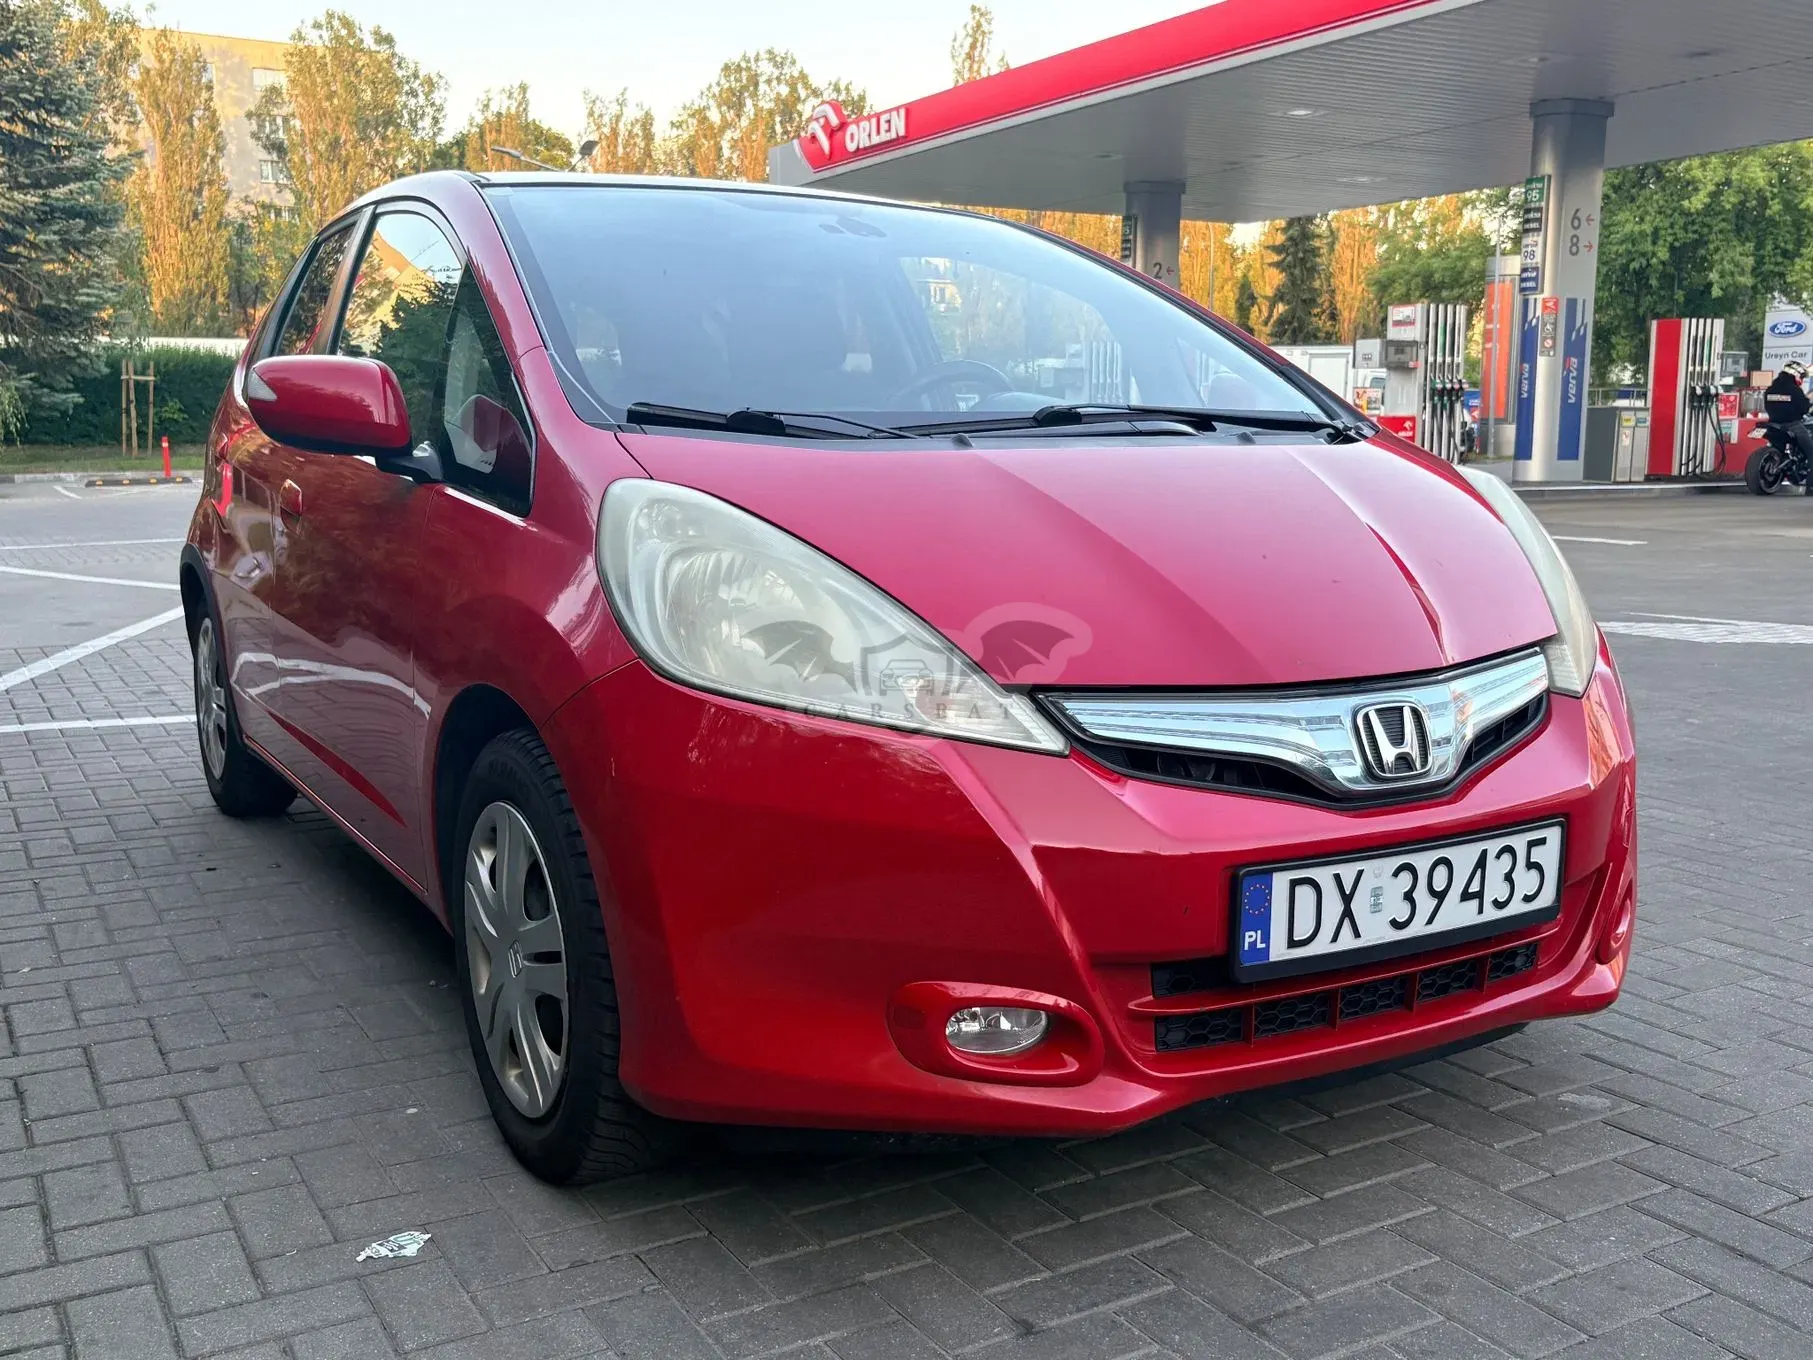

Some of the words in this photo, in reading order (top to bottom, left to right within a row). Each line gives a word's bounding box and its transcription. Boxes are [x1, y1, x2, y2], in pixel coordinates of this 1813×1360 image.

[844, 107, 906, 152] ORLEN
[1526, 189, 1540, 202] 95
[1570, 207, 1582, 230] 6
[1523, 249, 1535, 261] 98
[1568, 234, 1580, 256] 8
[1152, 261, 1162, 279] 2
[1774, 322, 1798, 334] Ford
[1791, 351, 1807, 359] Car
[1520, 363, 1529, 399] verva
[1567, 357, 1578, 403] verva
[1286, 868, 1365, 949] DX
[1388, 836, 1548, 932] 39435
[1243, 931, 1266, 951] PL
